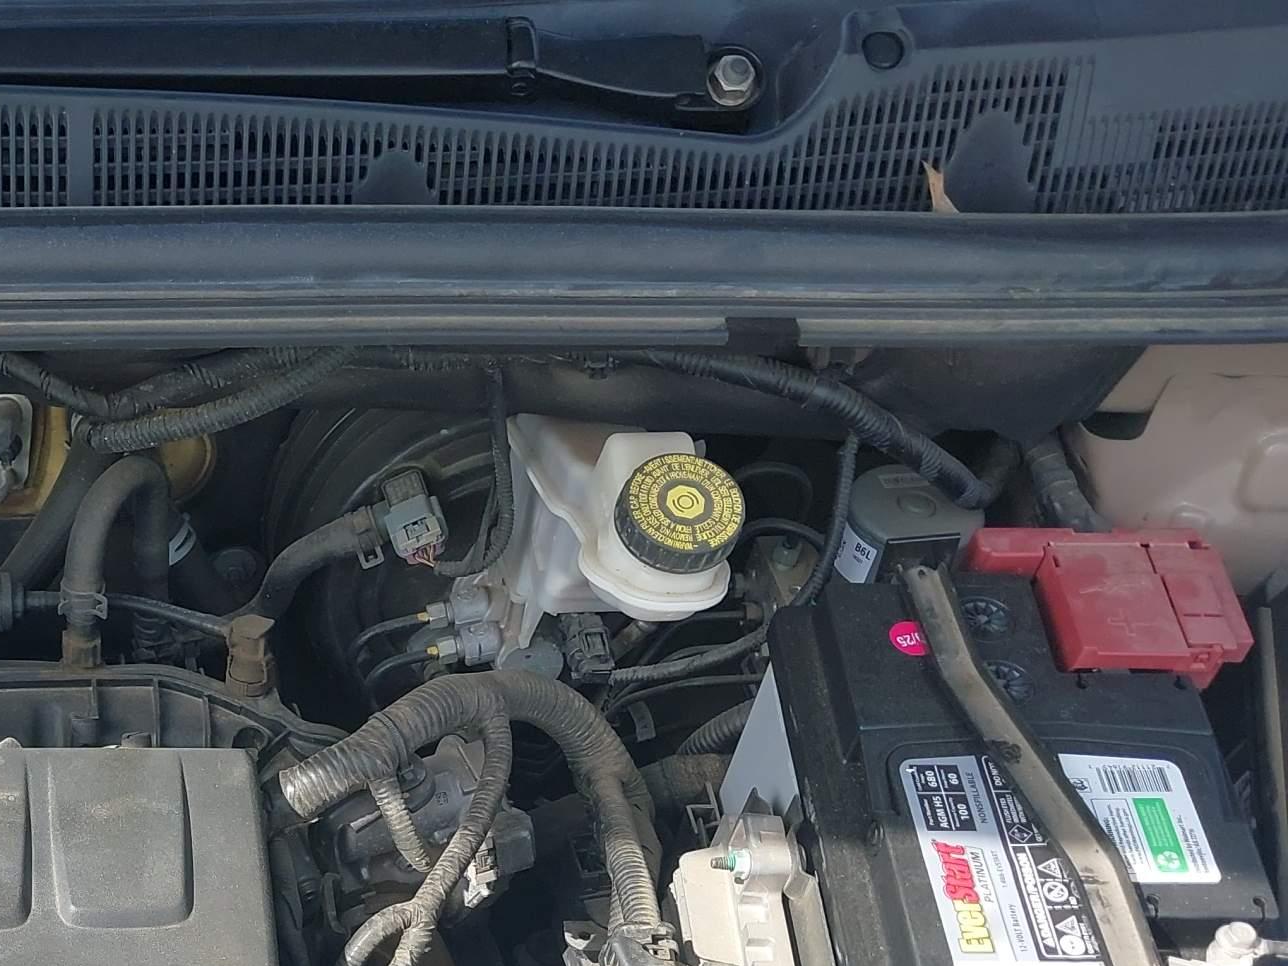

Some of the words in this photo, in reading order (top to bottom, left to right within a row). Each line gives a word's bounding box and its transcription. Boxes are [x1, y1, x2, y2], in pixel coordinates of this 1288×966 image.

[855, 542, 871, 561] B6L
[925, 770, 938, 786] 680
[947, 772, 959, 784] 60
[992, 775, 1002, 785] DO
[932, 795, 943, 806] H5
[968, 772, 988, 823] NONSPILLABLE
[935, 808, 949, 828] AGM
[956, 803, 970, 819] 100
[971, 851, 993, 902] PLATINUM
[932, 843, 994, 952] EverStart
